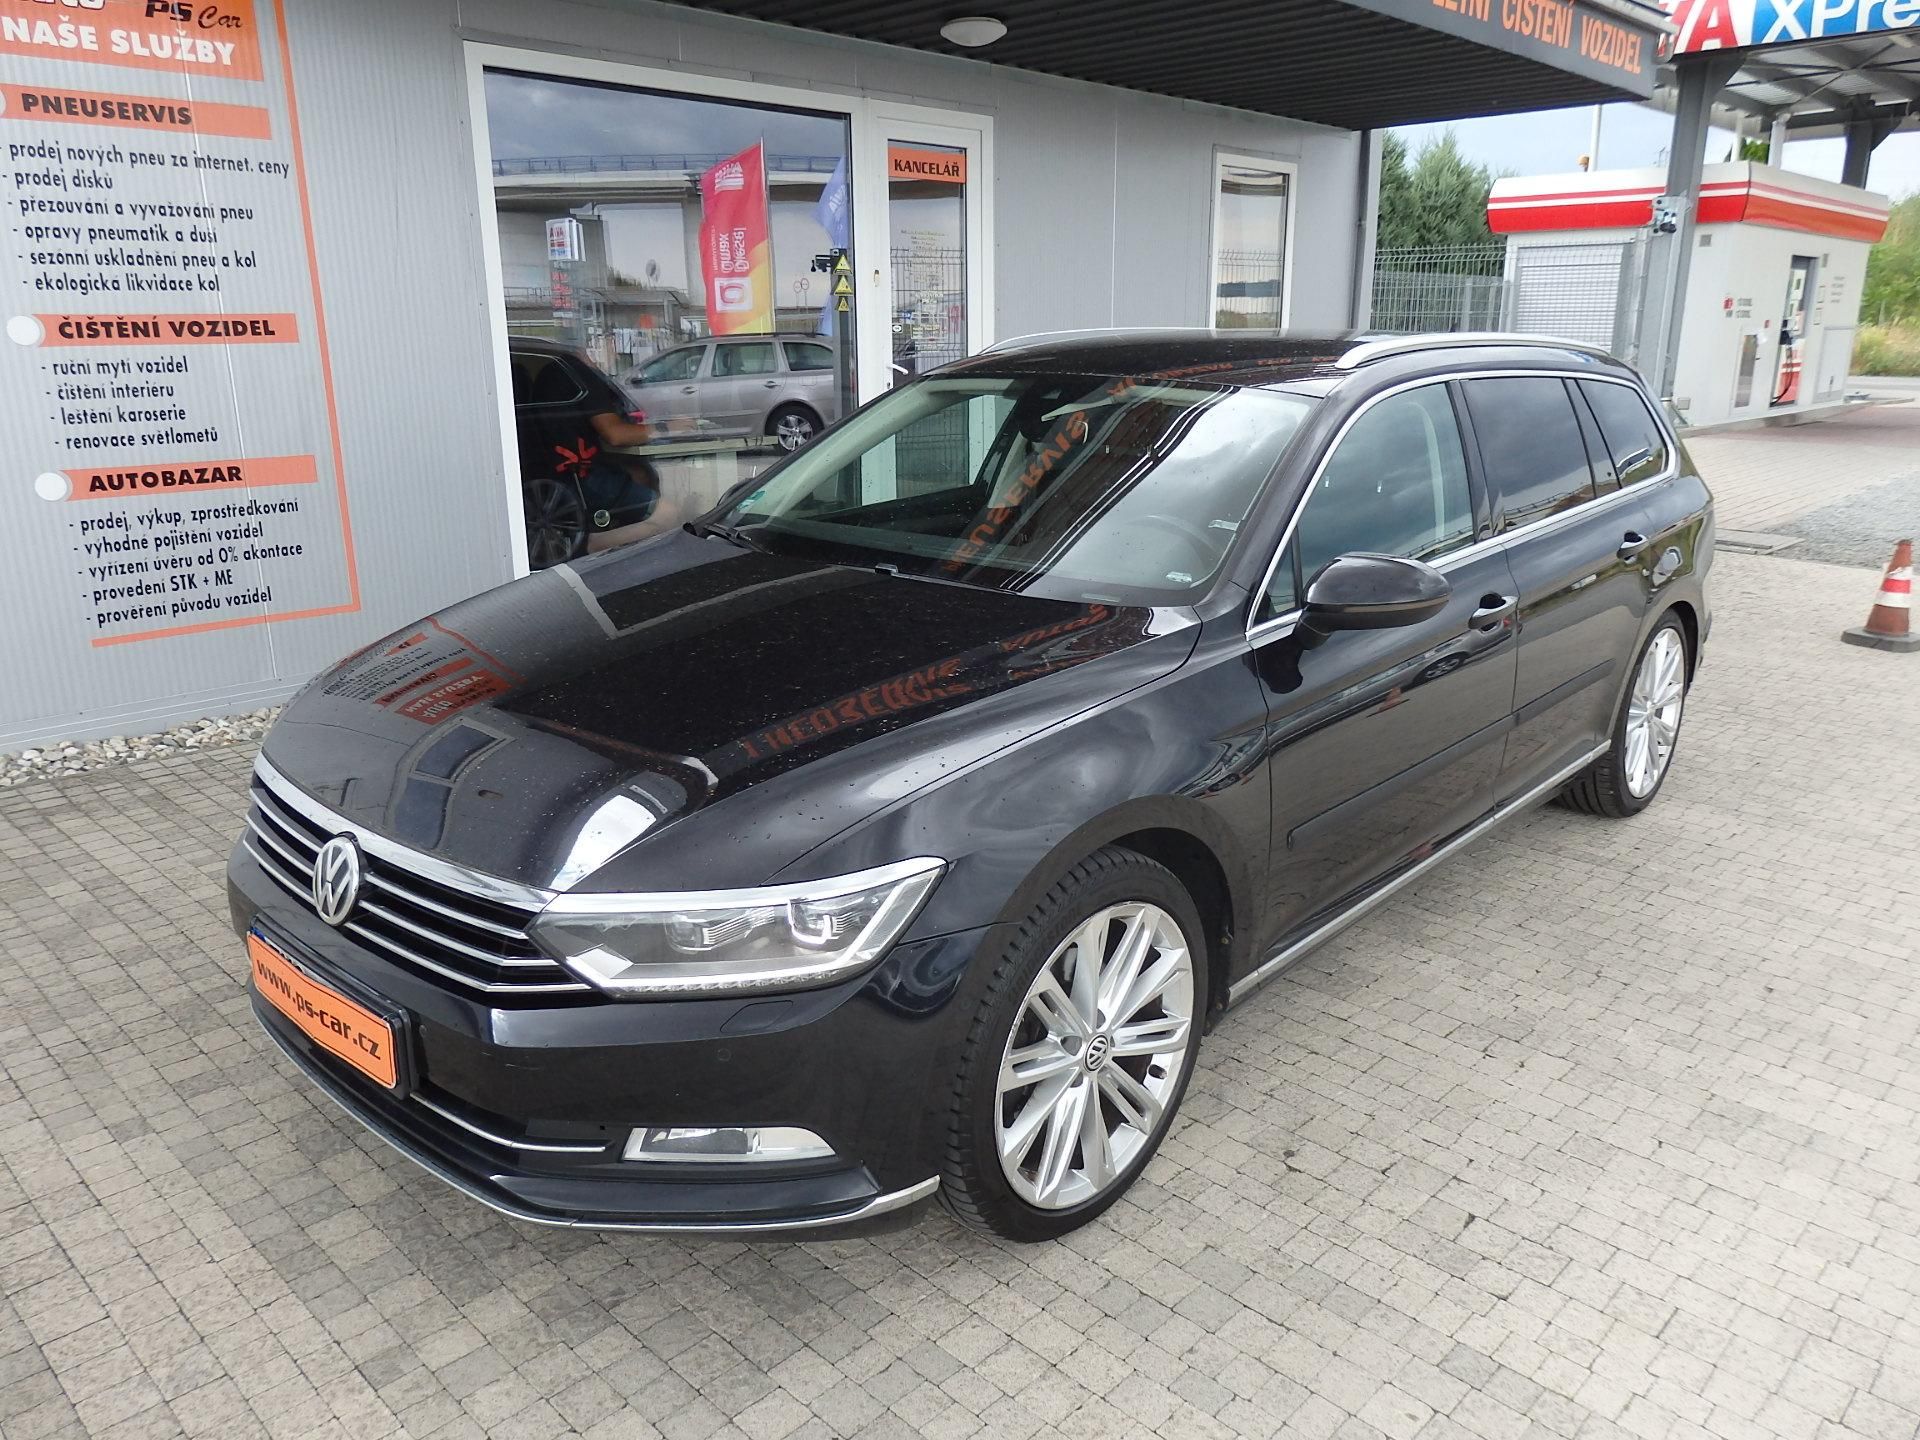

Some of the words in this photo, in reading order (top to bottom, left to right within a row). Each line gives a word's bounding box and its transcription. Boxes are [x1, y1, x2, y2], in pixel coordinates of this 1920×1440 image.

[198, 5, 243, 29] Car
[1, 15, 99, 51] NAŠE
[110, 29, 235, 66] SLUŽBY
[1580, 15, 1642, 74] VOZIDEL
[21, 92, 192, 125] PNEUSERVIS
[9, 139, 62, 164] prodej
[67, 144, 123, 167] nových
[129, 151, 165, 168] pneu
[171, 154, 188, 167] za
[258, 160, 289, 179] ceny
[894, 158, 960, 178] KANCELÁŘ
[15, 167, 67, 192] prodej
[20, 195, 109, 217] přezouvání
[115, 203, 124, 215] a
[130, 201, 215, 221] vyvažování
[220, 206, 253, 223] pneu
[25, 226, 81, 244] opravy
[88, 223, 169, 244] pneumatik
[175, 229, 184, 242] a
[30, 248, 89, 265] sezónní
[95, 248, 177, 267] uskladnění
[182, 253, 216, 271] pneu
[221, 255, 230, 267] a
[234, 250, 256, 267] kol
[35, 272, 120, 295] ekologická
[125, 273, 193, 291] likvidace
[198, 273, 220, 291] kol
[58, 316, 160, 339] ČIŠTĚNÍ
[168, 319, 275, 338] VOZIDEL
[53, 359, 91, 375] ruční
[136, 355, 188, 374] vozidel
[57, 382, 106, 400] čištění
[111, 381, 174, 399] interiéru
[60, 407, 113, 425] leštění
[116, 404, 186, 423] karoserie
[66, 433, 135, 450] renovace
[141, 426, 218, 446] světlometů
[89, 465, 243, 492] AUTOBAZAR
[81, 511, 132, 535] prodej,
[137, 508, 185, 530] výkup,
[191, 497, 299, 523] zprostředkování
[84, 534, 148, 558] výhodné
[154, 529, 212, 554] pojištění
[216, 520, 264, 542] vozidel
[89, 557, 149, 581] vyřízení
[153, 553, 193, 571] úvěru
[198, 549, 214, 566] od
[218, 546, 239, 564] 0%
[244, 543, 303, 561] akontace
[93, 580, 166, 606] provedení
[170, 573, 197, 592] STK
[215, 568, 234, 587] ME
[97, 601, 167, 628] prověření
[171, 593, 220, 617] původu
[225, 586, 272, 607] vozidel
[256, 959, 381, 1060] www.ps-car.cz
